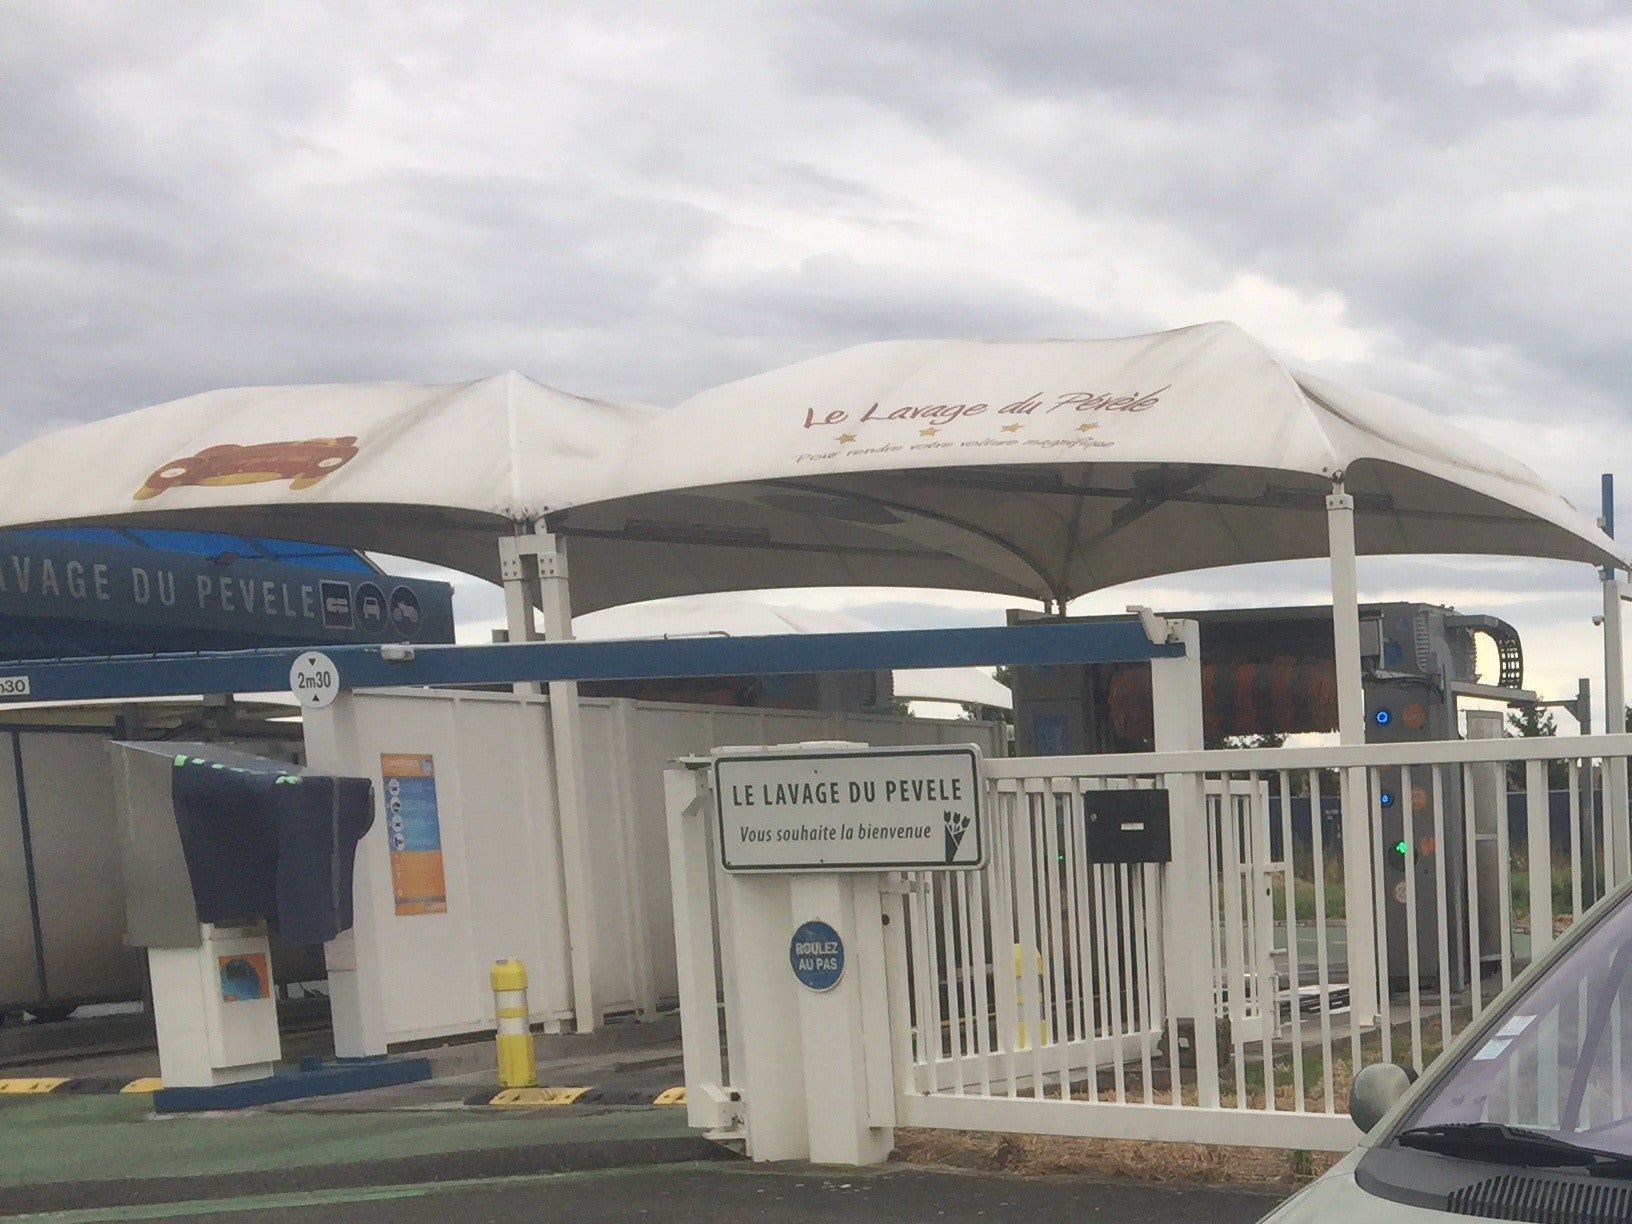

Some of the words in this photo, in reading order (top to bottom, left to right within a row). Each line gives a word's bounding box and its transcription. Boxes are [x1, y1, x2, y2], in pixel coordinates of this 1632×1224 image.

[803, 407, 848, 429] Le
[860, 402, 989, 425] Lavage
[998, 391, 1046, 415] du
[133, 568, 176, 607] DU
[199, 578, 317, 619] PEVELE
[297, 671, 331, 689] 2m30
[733, 785, 755, 806] LE
[764, 782, 840, 806] LAVAGE
[850, 781, 876, 803] DU
[886, 778, 962, 802] PEVELE
[740, 826, 772, 842] Vous
[776, 825, 836, 842] souhaite
[840, 824, 854, 839] la
[858, 823, 932, 840] bienvenue
[796, 941, 838, 955] ROULEZ
[799, 959, 814, 970] AU
[816, 958, 838, 970] PAS
